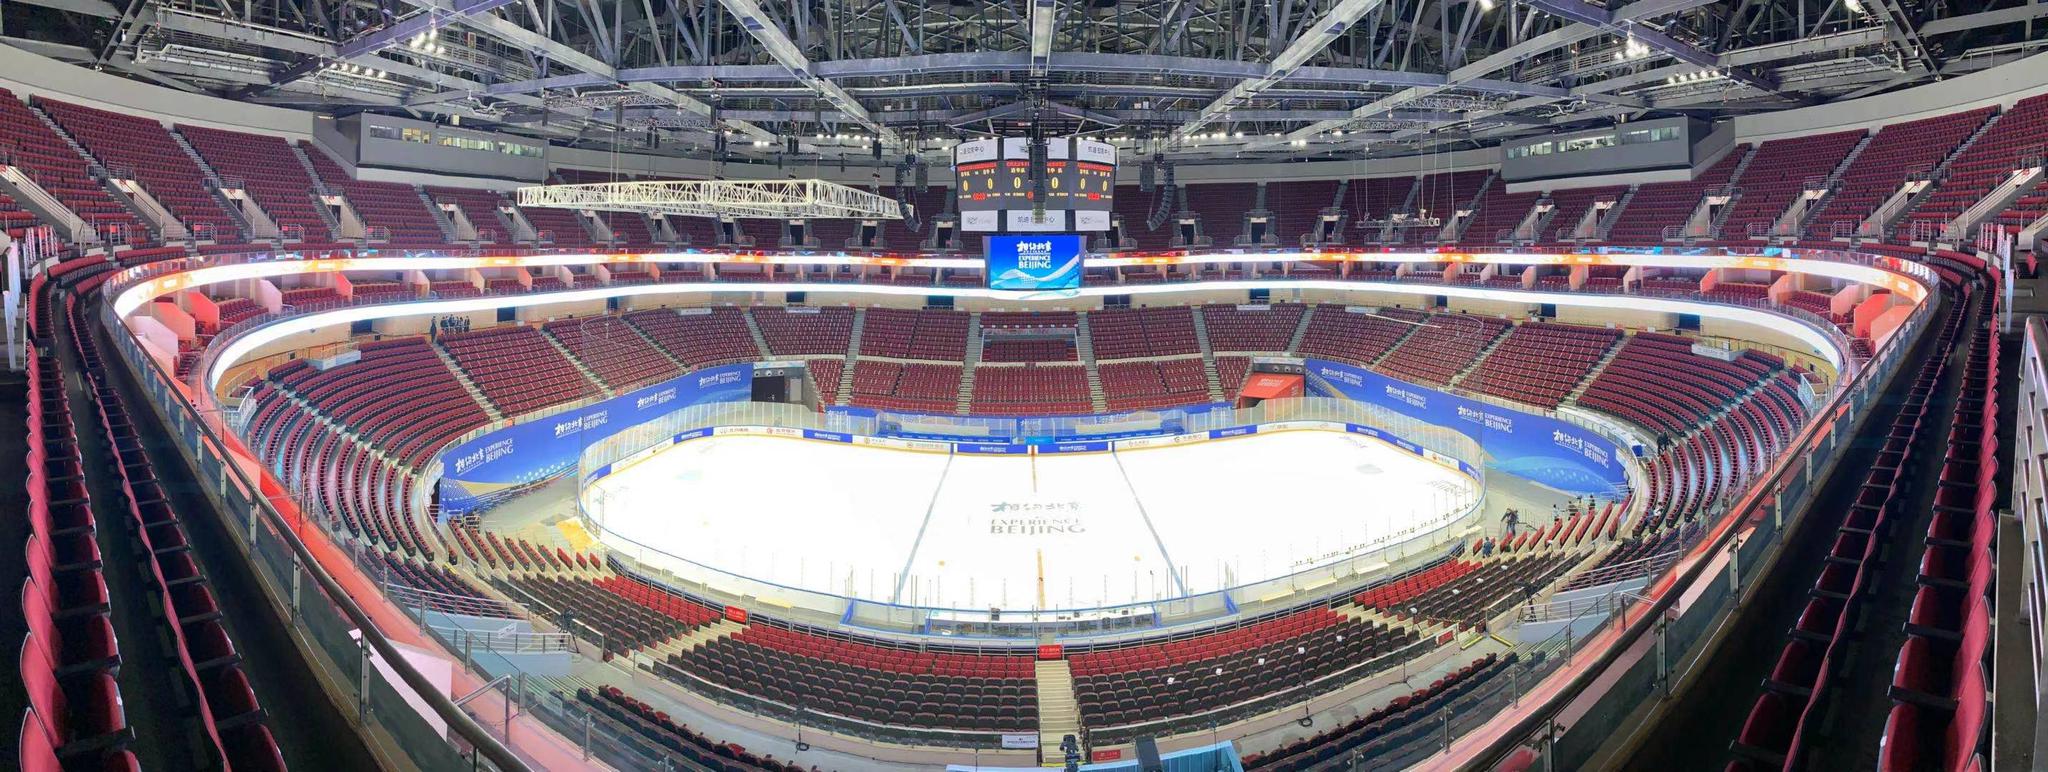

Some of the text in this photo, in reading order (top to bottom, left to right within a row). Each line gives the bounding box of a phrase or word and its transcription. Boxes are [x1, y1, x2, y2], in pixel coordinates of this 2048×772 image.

[1018, 261, 1051, 270] BEIJING
[584, 416, 608, 430] BEIJING
[1485, 419, 1512, 434] BEIJING
[486, 445, 514, 463] BEIJING
[1584, 447, 1609, 469] BEIJING
[990, 525, 1086, 535] BEIJING
